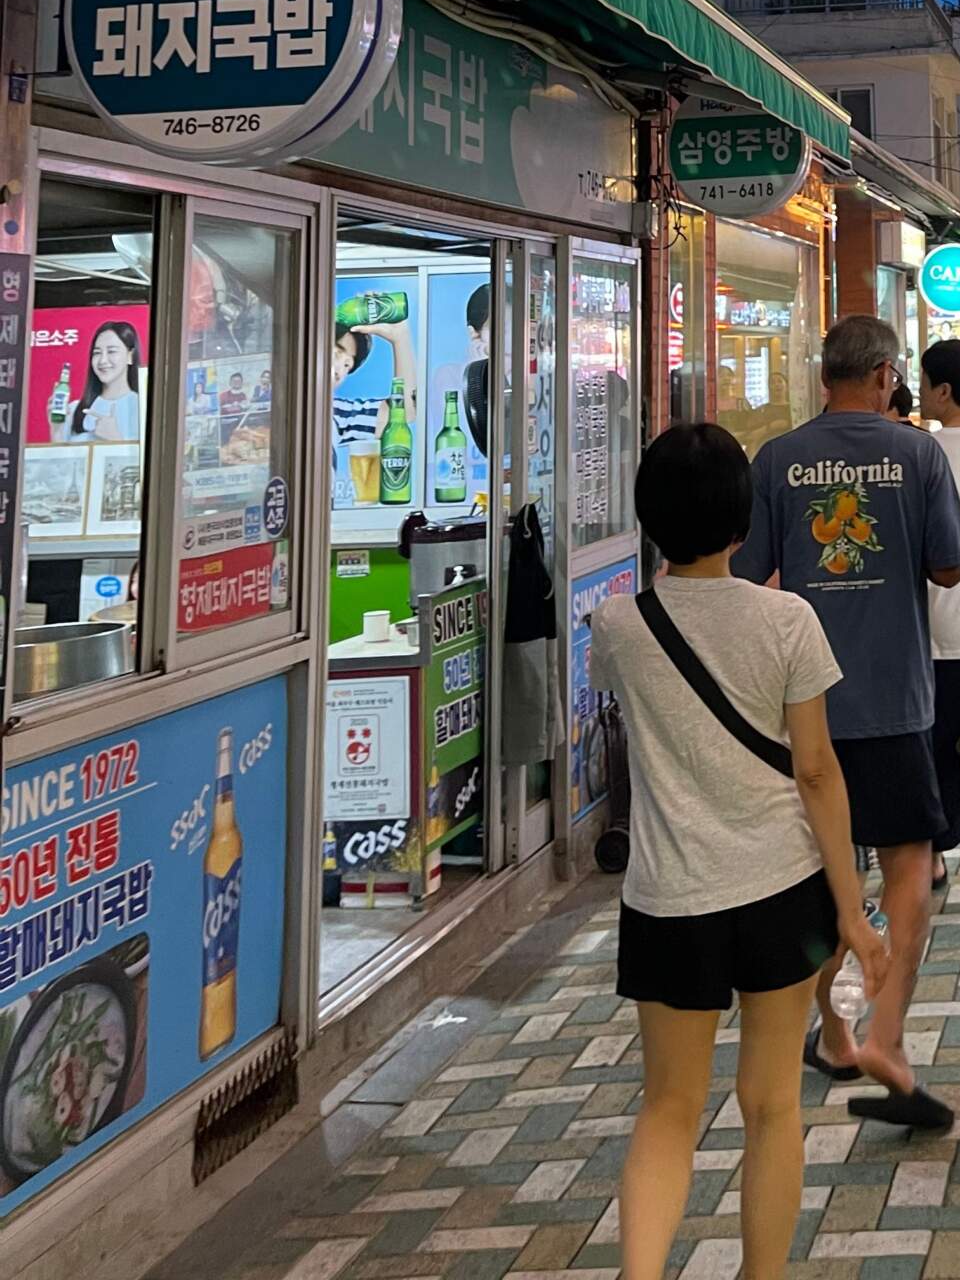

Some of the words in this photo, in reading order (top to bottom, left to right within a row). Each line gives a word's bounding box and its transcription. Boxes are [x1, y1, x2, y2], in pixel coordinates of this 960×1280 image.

[162, 114, 261, 137] 746-8726
[677, 126, 794, 166] 삼영주방
[700, 182, 775, 201] 741-6418
[381, 457, 411, 469] TERRA
[787, 456, 904, 488] California
[433, 594, 474, 645] SINCE
[79, 738, 140, 804] 1972
[238, 723, 273, 775] Cass
[65, 810, 121, 886] 전통
[343, 819, 408, 865] Cass
[203, 870, 242, 949] Cass
